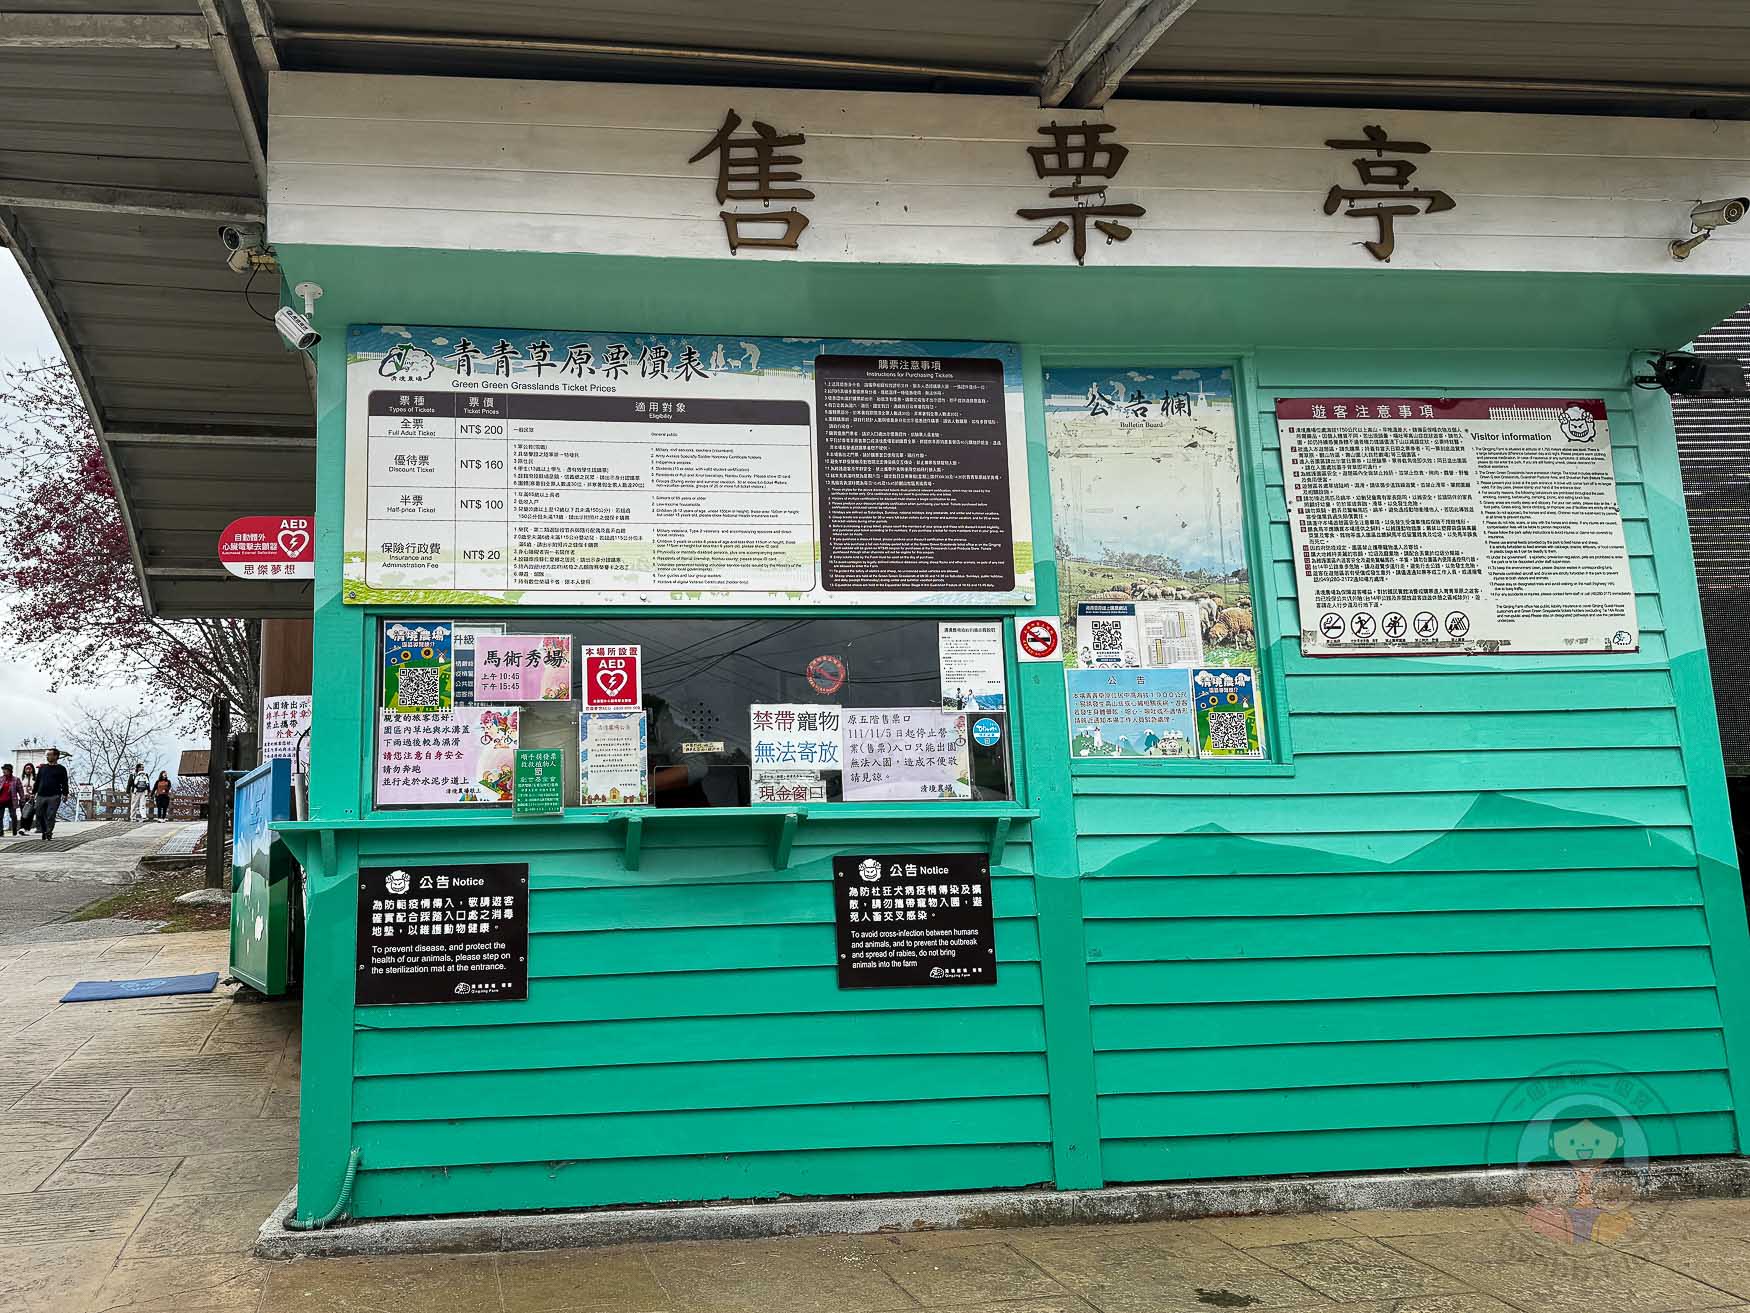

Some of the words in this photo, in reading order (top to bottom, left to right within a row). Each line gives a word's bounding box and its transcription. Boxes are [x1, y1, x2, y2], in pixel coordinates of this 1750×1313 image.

[688, 107, 1456, 264] 售票亭
[444, 338, 710, 382] 青青草原票價表
[878, 360, 942, 371] 購票注意事項
[452, 380, 478, 388] Green
[482, 381, 508, 389] Green
[512, 382, 559, 391] Grasslands
[562, 383, 588, 392] Ticket
[400, 396, 425, 406] 票種
[469, 397, 494, 407] 票價
[1086, 389, 1191, 417] 公告欄
[635, 402, 686, 412] 適用對象
[1312, 405, 1434, 418] 遊客注意事項
[401, 419, 424, 429] 全票
[460, 425, 481, 435] NT$
[484, 426, 503, 434] 200
[1471, 433, 1499, 441] Visitor
[1502, 433, 1552, 441] information
[394, 455, 430, 466] 優待票
[460, 460, 481, 470] NT$
[485, 461, 503, 469] 160
[400, 495, 424, 506] 半票
[460, 500, 481, 510] NT$
[485, 501, 503, 509] 100
[280, 520, 307, 529] AED
[235, 533, 265, 541] 自動體外
[381, 543, 441, 554] 保險行政費
[463, 550, 484, 560] NT$
[488, 551, 501, 560] 20
[586, 647, 638, 656] 本場所設置
[484, 649, 564, 668] 馬術秀場
[599, 660, 626, 668] AED
[1108, 676, 1145, 685] 公告
[753, 710, 839, 731] 禁帶寵物
[848, 714, 911, 724] 原五階售票口
[384, 726, 470, 735] 園區內草地與水溝蓋
[849, 729, 891, 738] 111/11/5
[383, 751, 464, 760] 請您注意自身安全
[755, 740, 839, 763] 無法寄放
[383, 765, 421, 774] 請勿奔跑
[382, 777, 470, 786] 並行走於水泥步道上
[850, 772, 890, 783] 請見諒。
[759, 785, 823, 802] 現金窗口
[890, 864, 917, 877] 公告
[920, 866, 949, 875] Notice
[419, 876, 449, 889] 公告
[452, 877, 485, 886] Notice
[372, 909, 514, 924] 確實配合踩踏入口處之消毒
[850, 910, 936, 922] 免人畜交叉感染。
[880, 929, 924, 937] cross-infection
[384, 945, 413, 954] prevent
[415, 943, 446, 952] disease,
[466, 942, 491, 951] protect
[865, 940, 891, 949] animals,
[914, 940, 937, 948] prevent
[950, 938, 978, 946] outbreak
[422, 954, 453, 962] animals,
[456, 952, 480, 961] please
[483, 952, 499, 961] step
[865, 951, 887, 959] spread
[896, 950, 918, 958] rabies,
[940, 949, 956, 957] bring
[385, 964, 429, 973] sterilization
